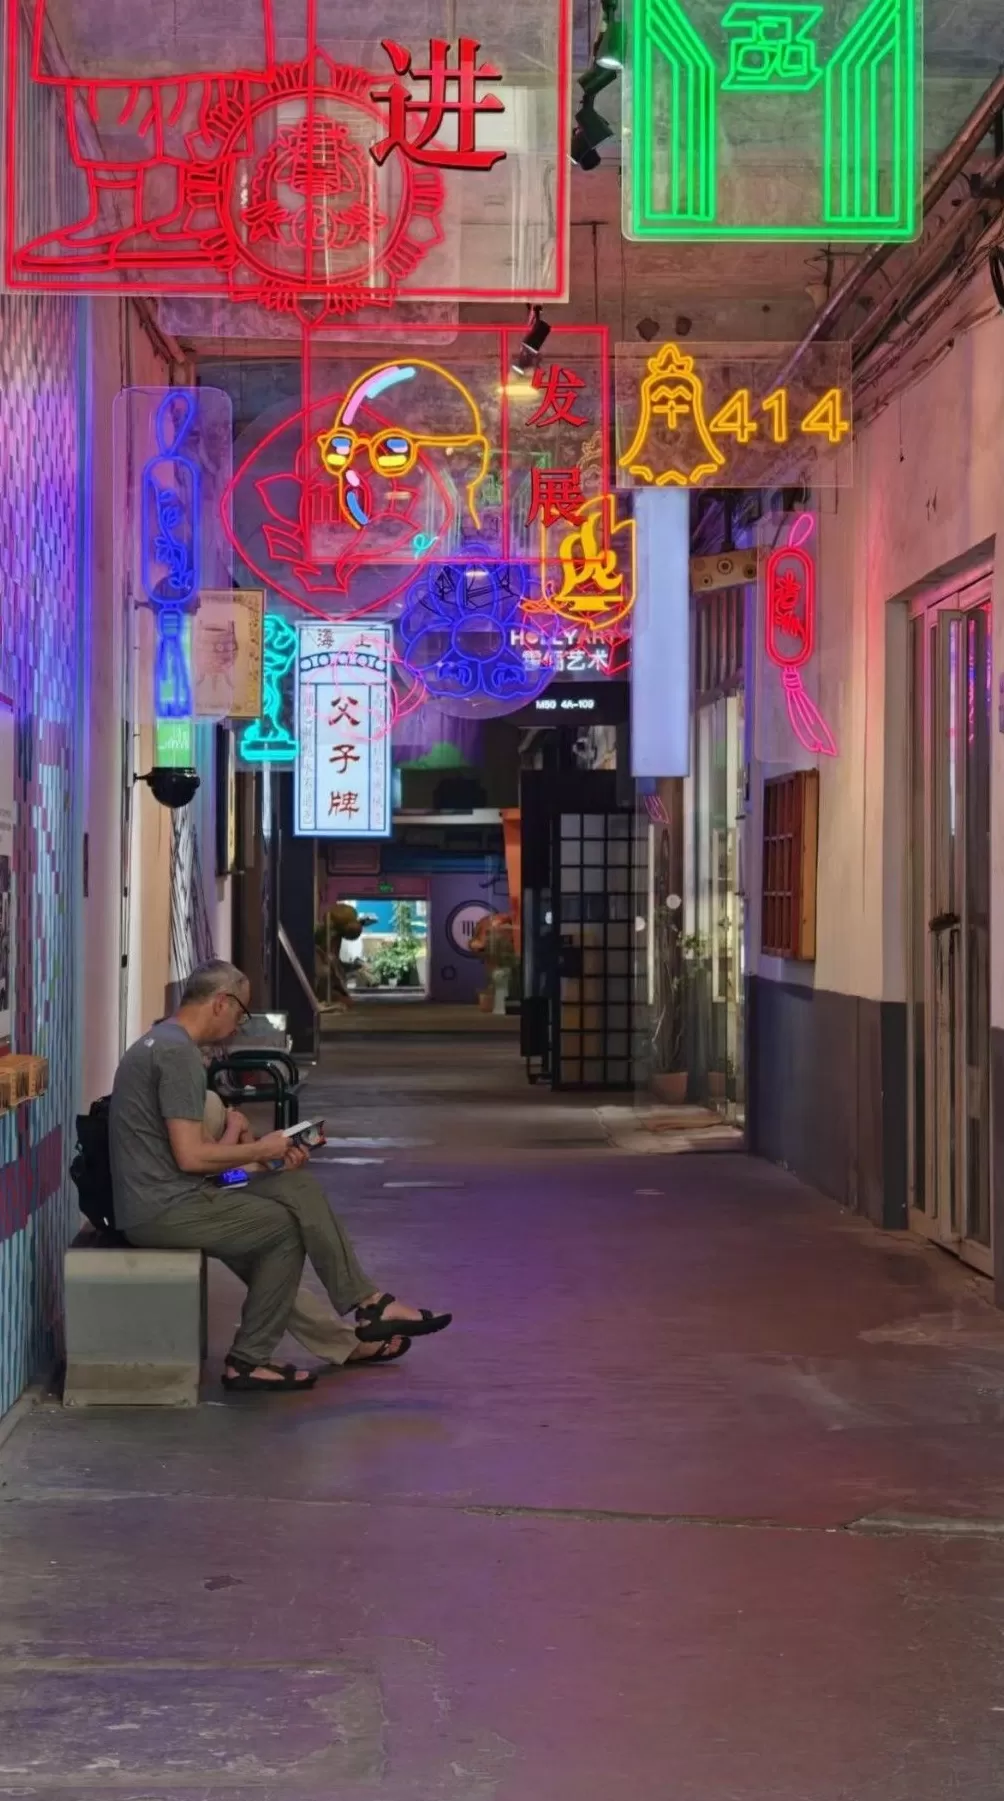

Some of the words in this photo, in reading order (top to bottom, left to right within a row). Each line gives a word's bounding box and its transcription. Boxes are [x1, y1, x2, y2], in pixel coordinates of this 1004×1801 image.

[369, 36, 507, 170] 进
[525, 364, 589, 528] 发展
[709, 387, 850, 444] 414
[328, 696, 360, 822] 父子牌
